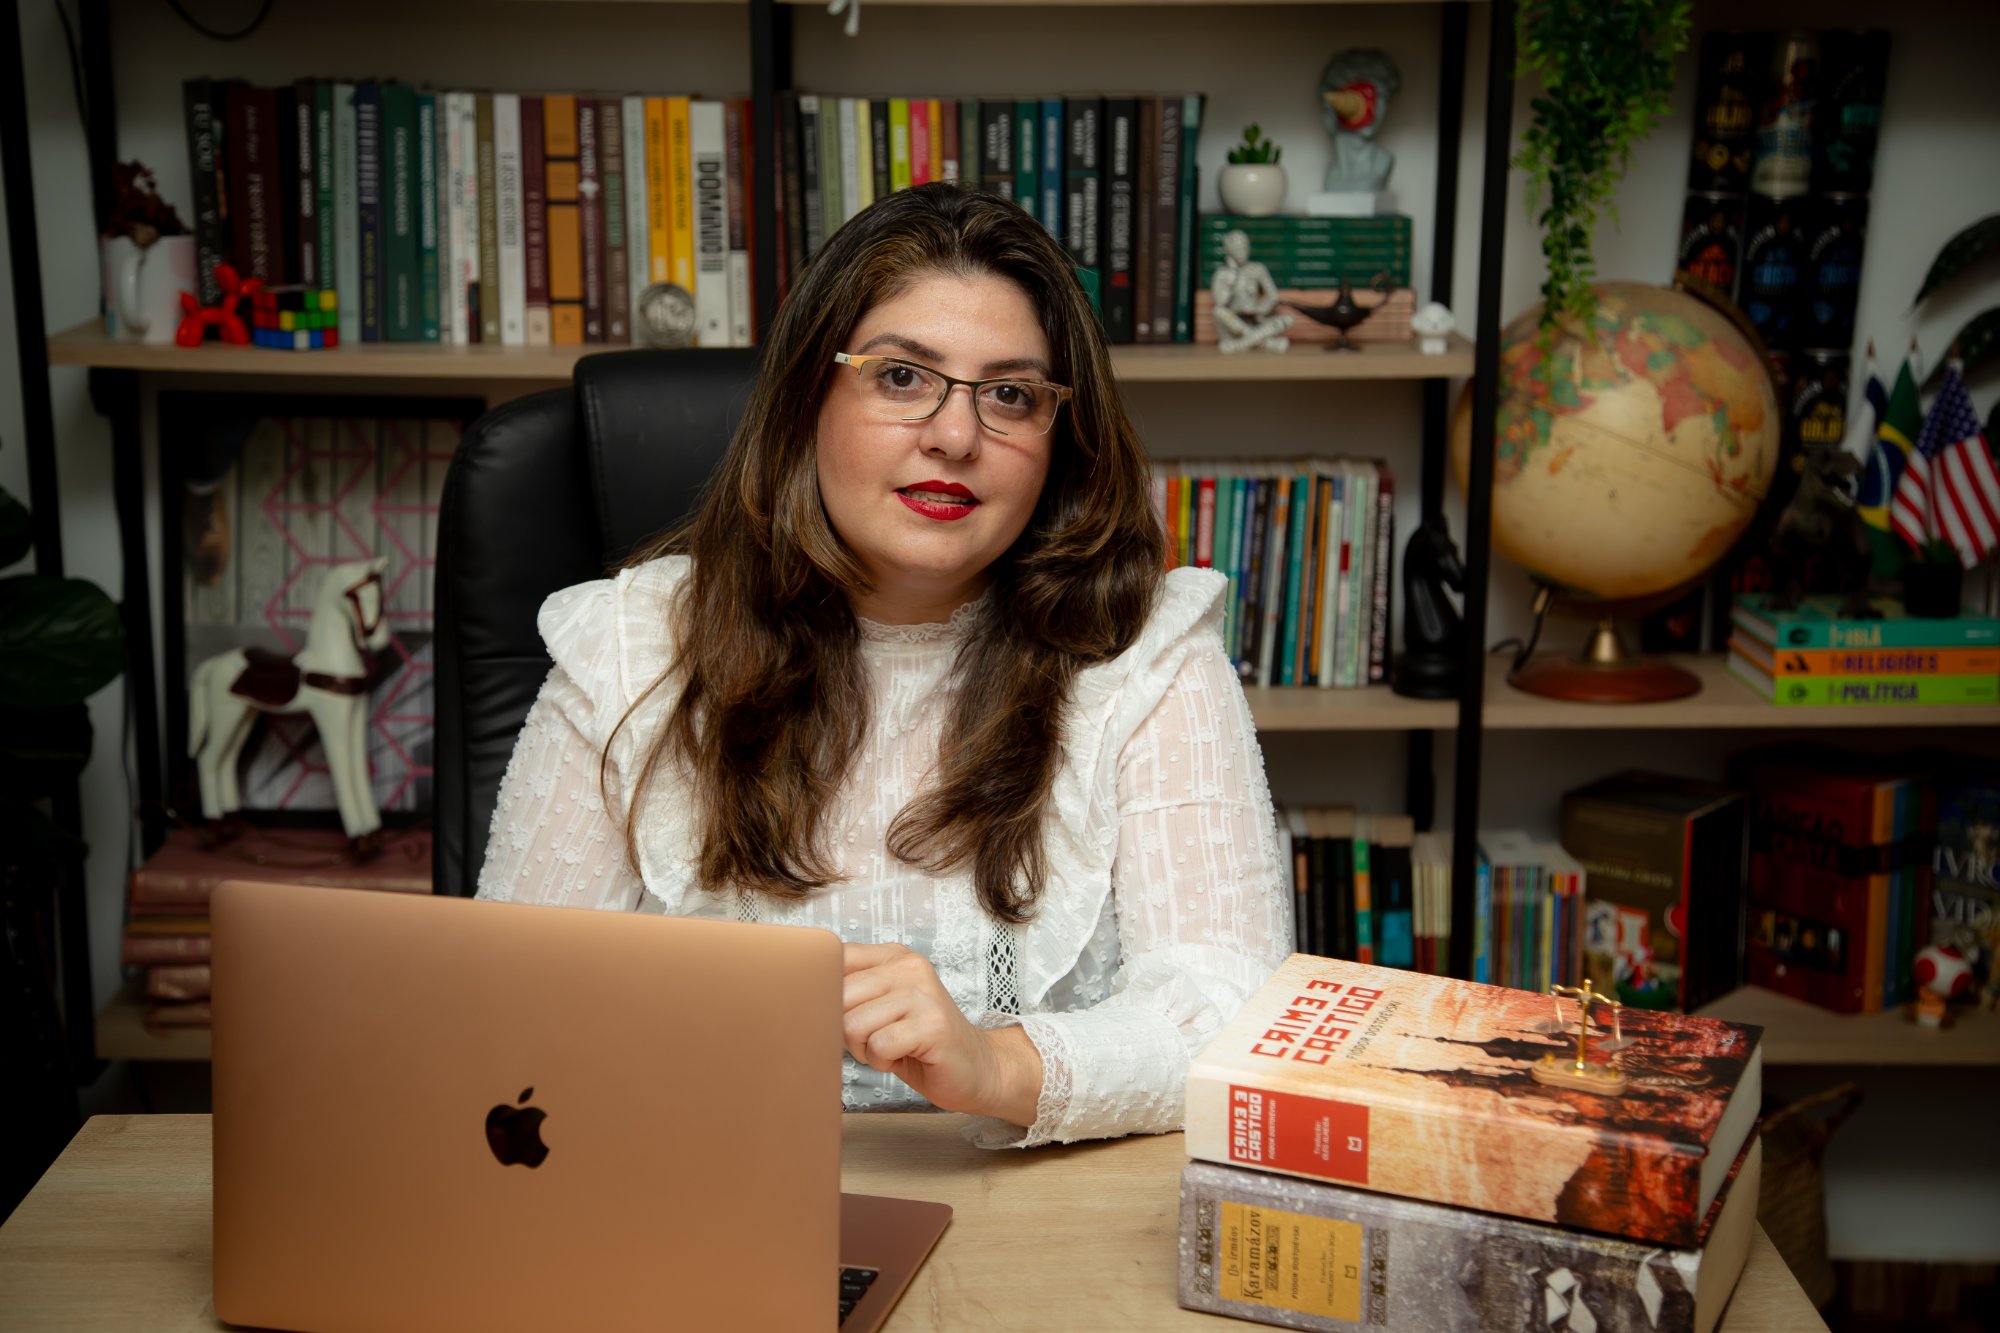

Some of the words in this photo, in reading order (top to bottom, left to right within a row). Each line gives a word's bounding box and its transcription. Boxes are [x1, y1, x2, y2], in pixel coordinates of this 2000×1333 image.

[1844, 652, 1938, 672] RELIGIÕES
[1842, 681, 1918, 701] POLÍTICA
[1251, 997, 1328, 1058] CRIME
[1307, 980, 1343, 992] E
[1292, 986, 1384, 1065] CASTIGO
[1234, 1090, 1248, 1102] E
[1234, 1105, 1248, 1159] CRIME
[1248, 1092, 1263, 1162] CASTIGO
[1230, 1226, 1239, 1261] irmãos
[1243, 1211, 1264, 1300] Karamázov
[1228, 1262, 1240, 1277] Os
